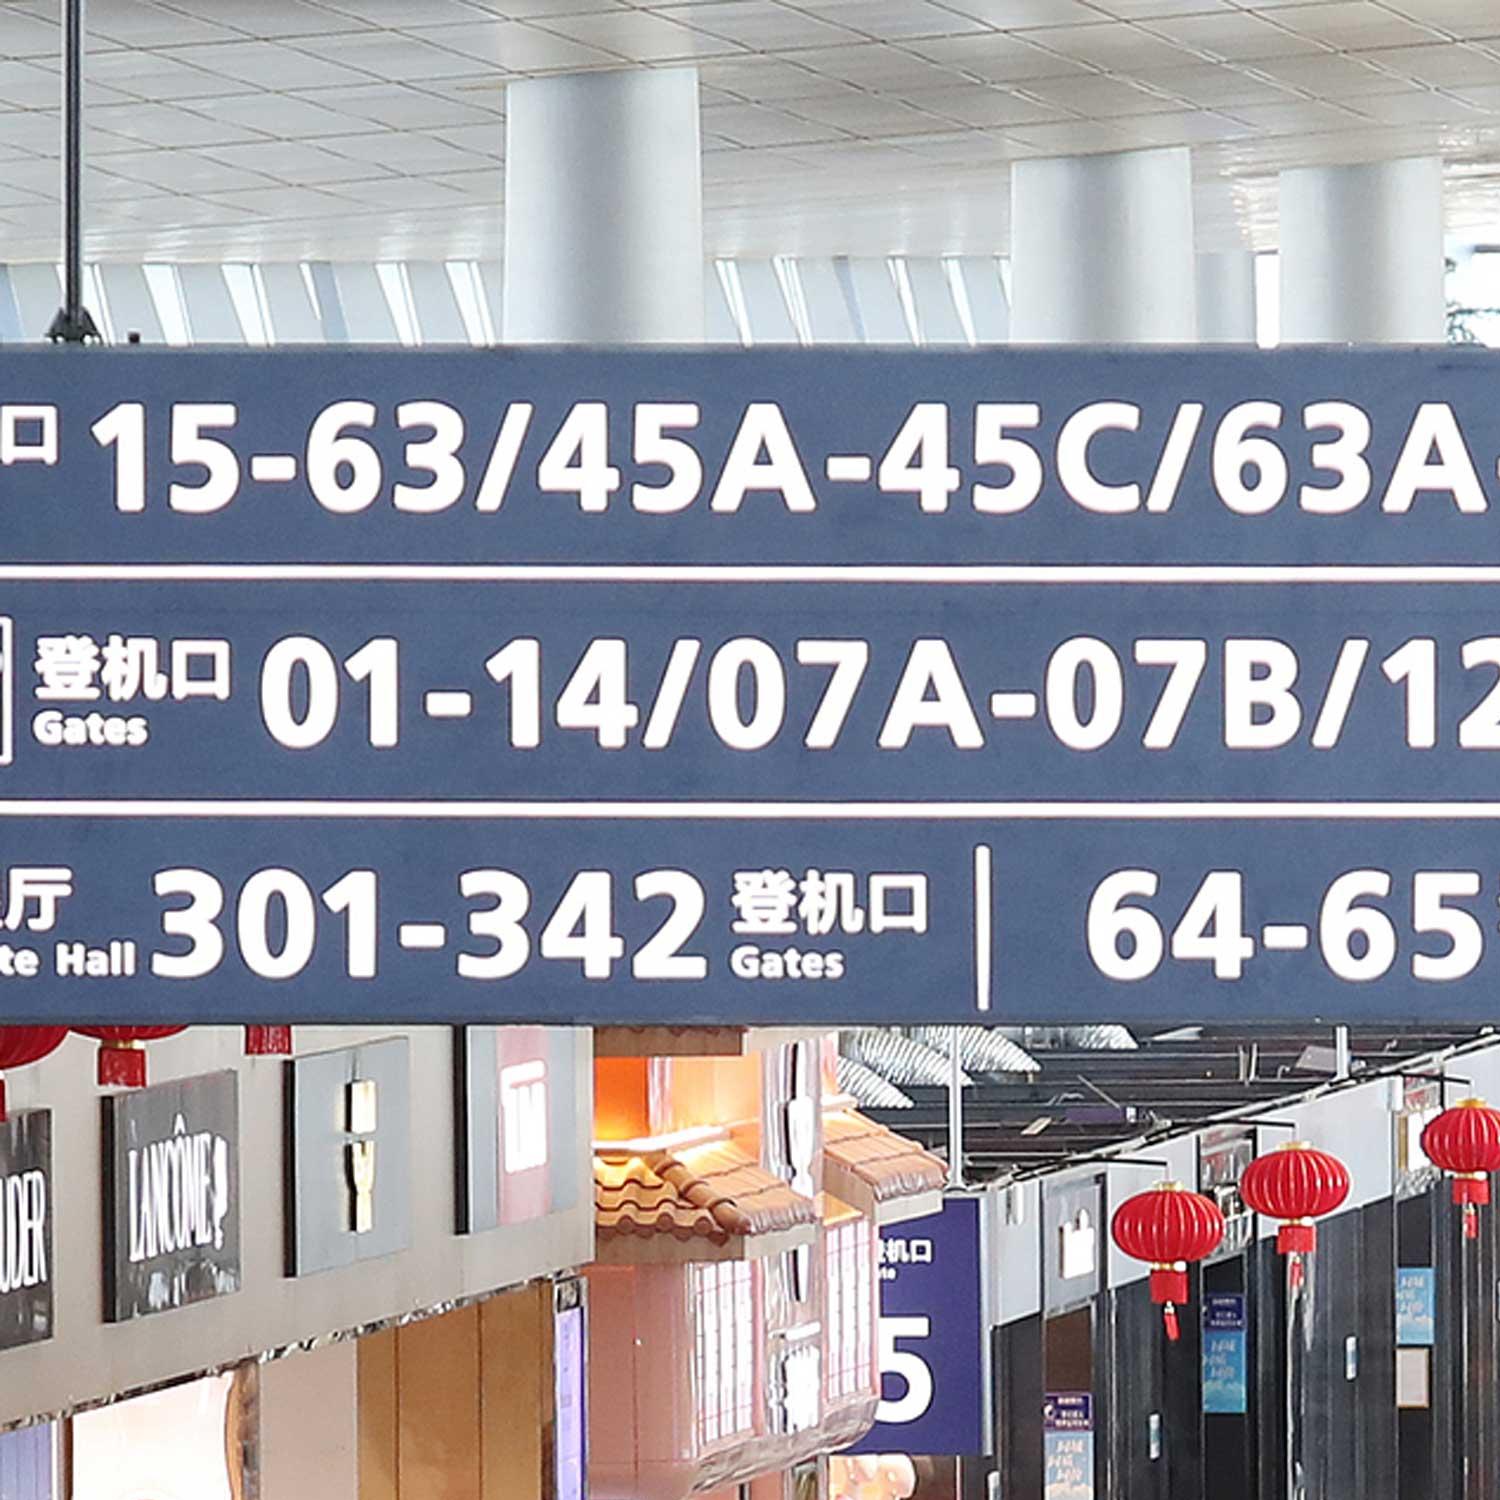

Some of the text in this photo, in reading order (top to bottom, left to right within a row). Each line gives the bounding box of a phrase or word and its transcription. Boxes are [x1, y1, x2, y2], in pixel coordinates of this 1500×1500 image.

[34, 635, 230, 702] 登机口
[33, 710, 148, 745] Gates
[153, 868, 707, 979] 301-342
[731, 869, 927, 935] 登机口
[1087, 870, 1482, 981] 64-65
[56, 941, 135, 976] Hall
[731, 945, 844, 979] Gates
[129, 1113, 212, 1263] LANCÔME
[880, 1238, 932, 1263] 机口
[875, 1316, 933, 1424] 5
